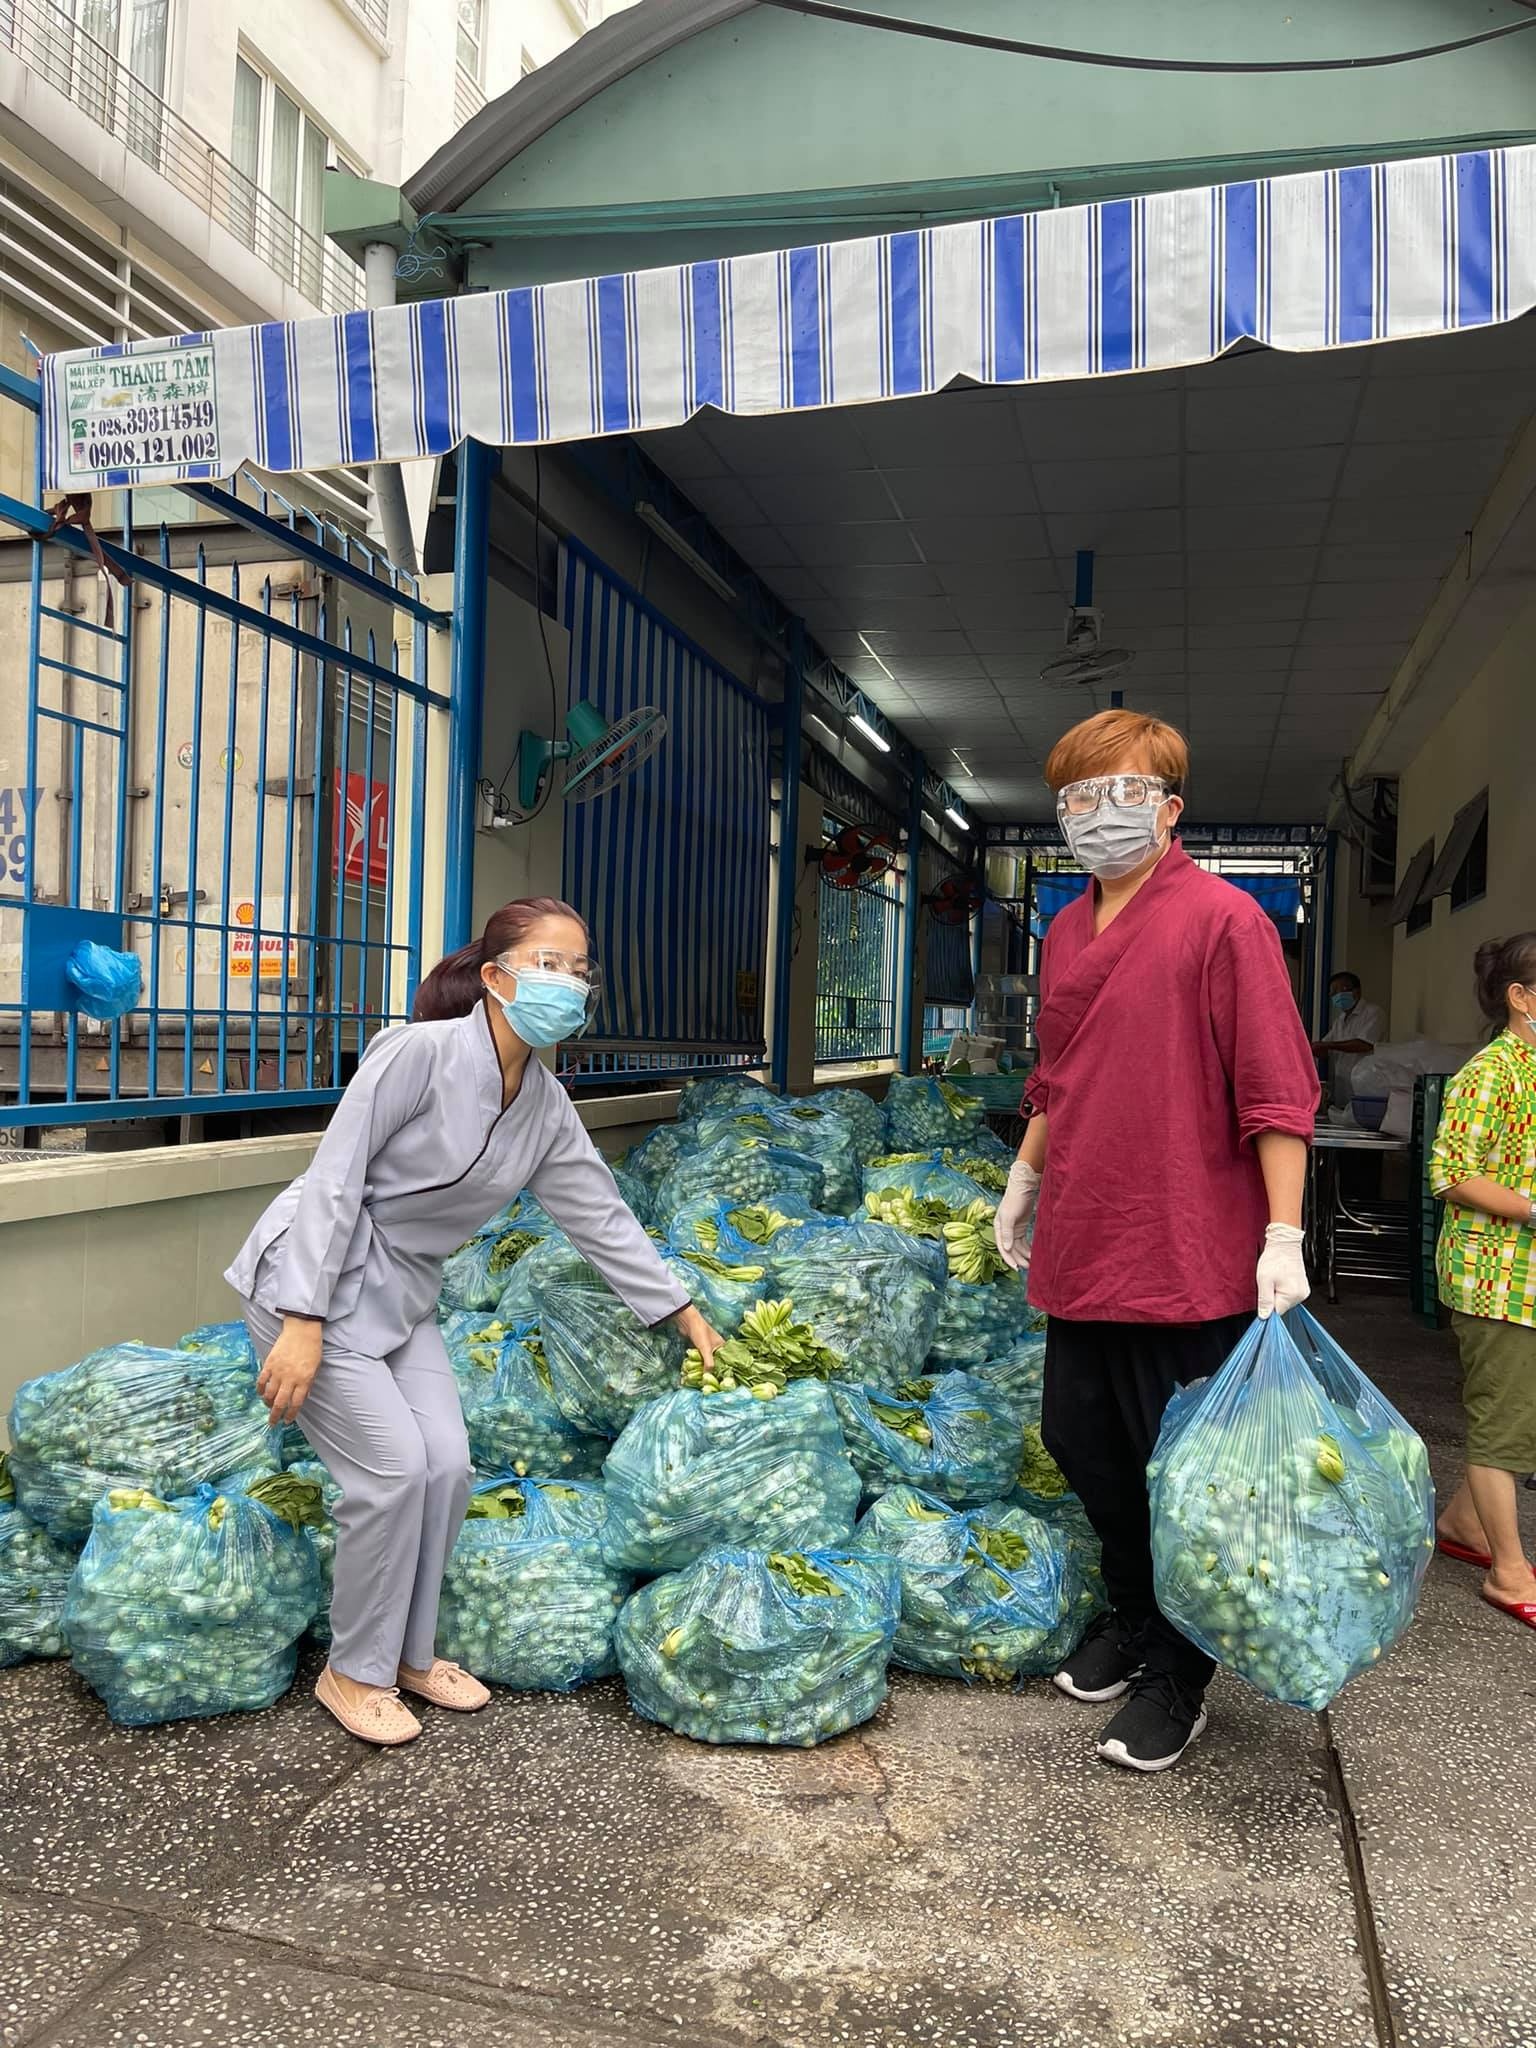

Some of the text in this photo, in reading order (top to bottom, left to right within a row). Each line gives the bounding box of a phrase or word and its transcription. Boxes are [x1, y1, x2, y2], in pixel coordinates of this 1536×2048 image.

[109, 353, 211, 388] THANH TÂM
[88, 432, 216, 469] 0908.121.002
